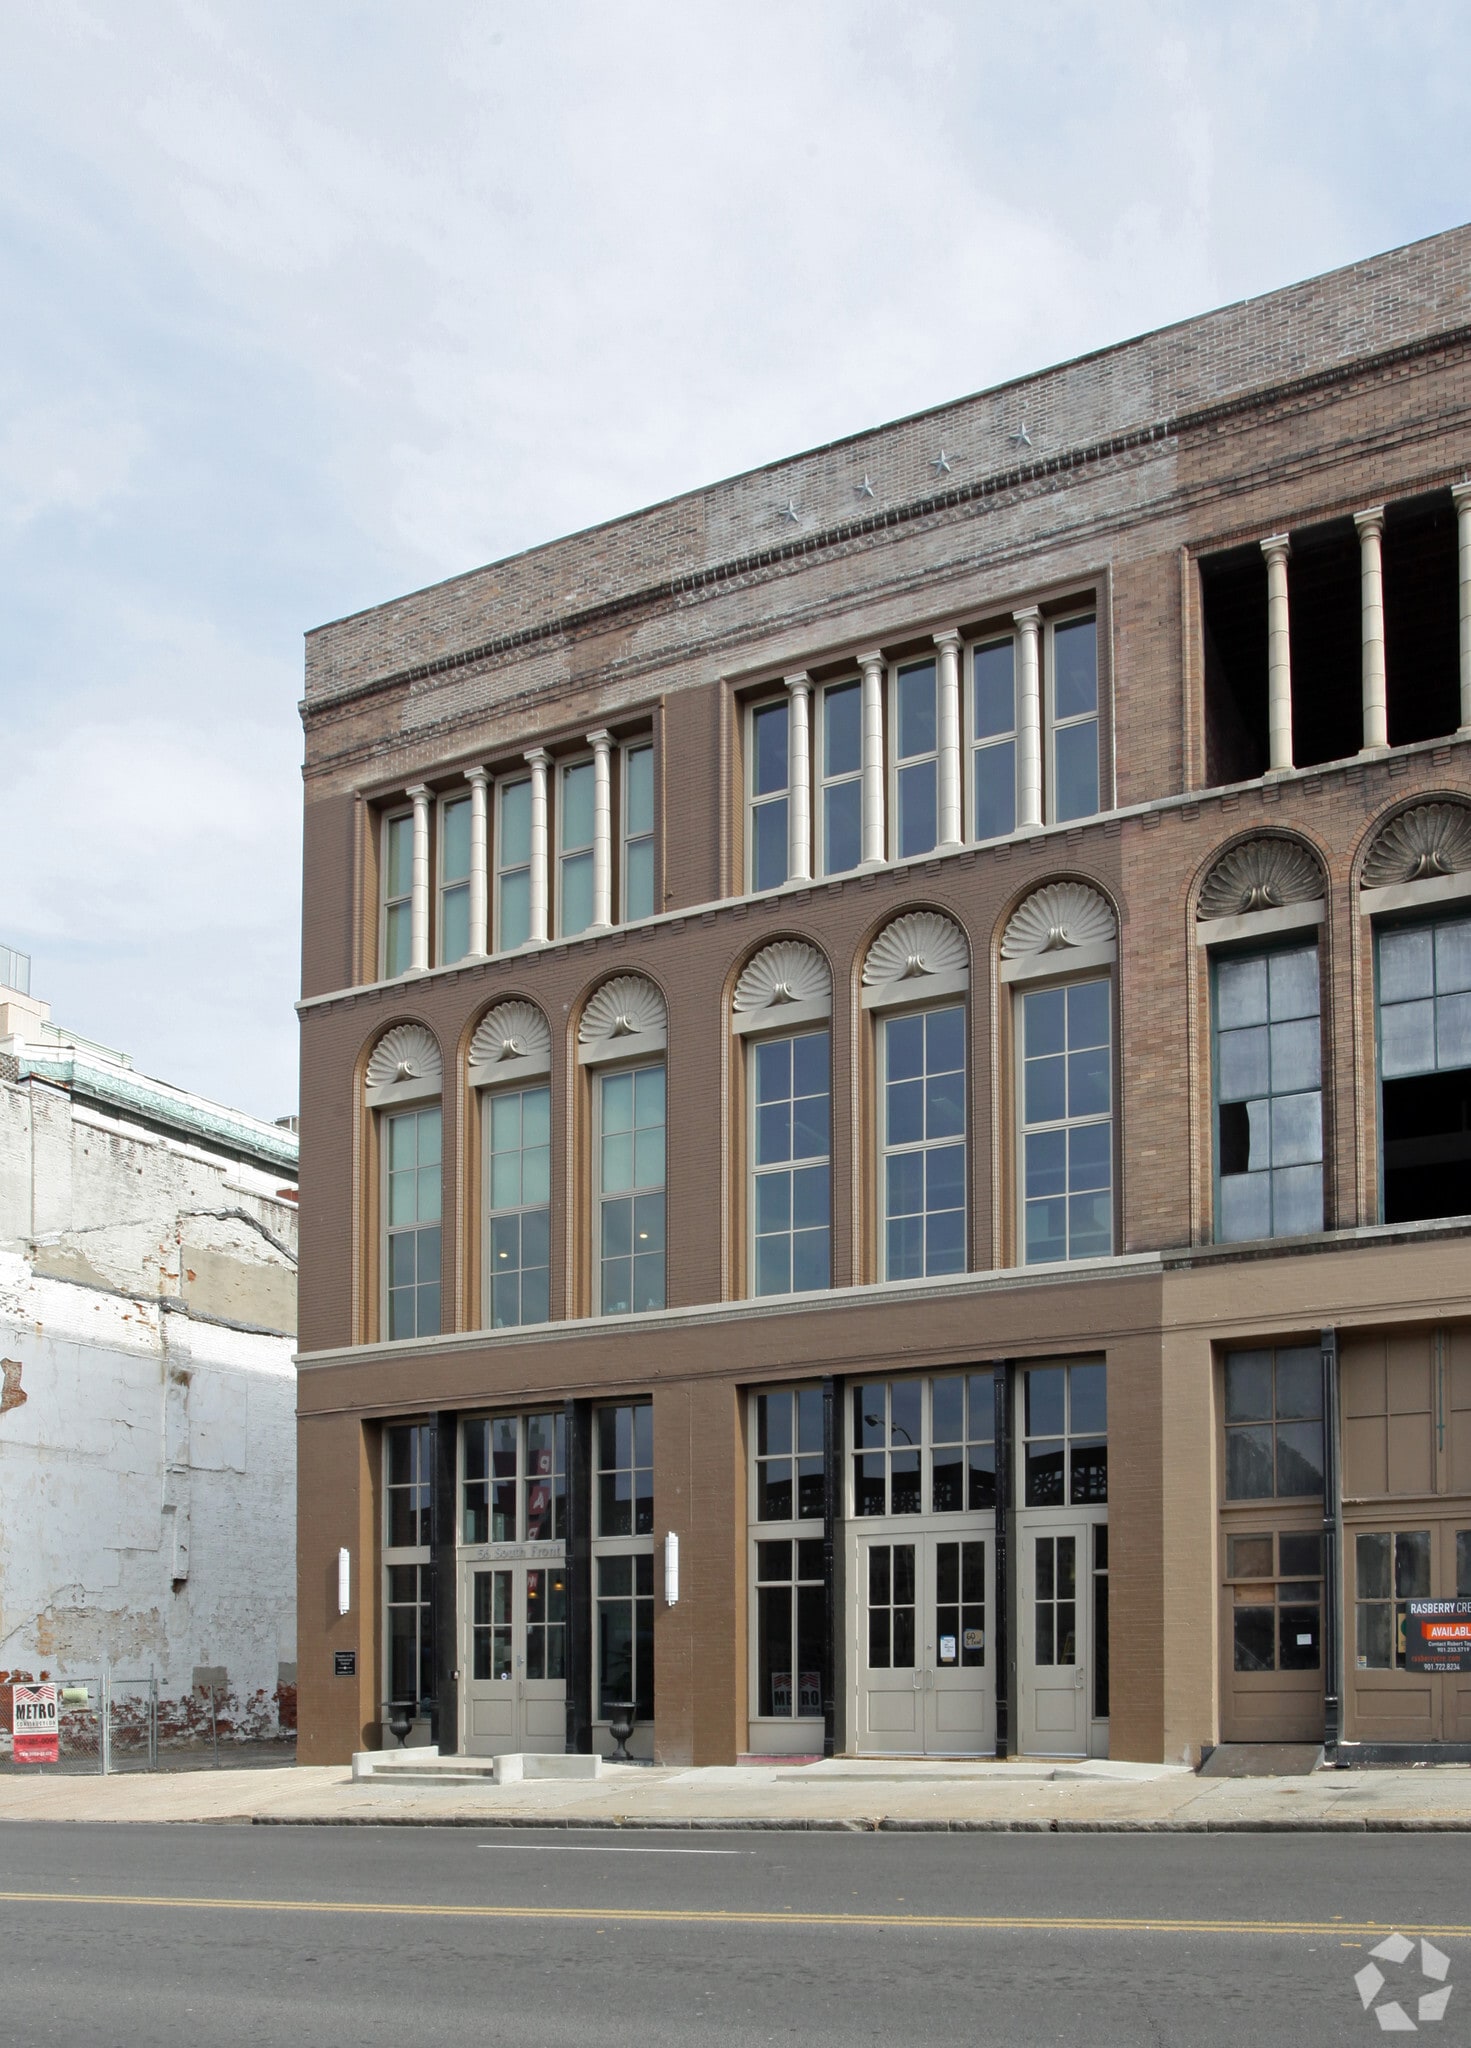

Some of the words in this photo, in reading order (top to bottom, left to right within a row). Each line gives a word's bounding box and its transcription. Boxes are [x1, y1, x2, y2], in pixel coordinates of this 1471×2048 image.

[495, 1547, 526, 1558] South
[531, 1545, 561, 1557] Front
[1410, 1602, 1455, 1614] RASBERRY
[1431, 1626, 1471, 1637] AVAILABL
[774, 1690, 819, 1706] MERO
[16, 1703, 55, 1719] METRO
